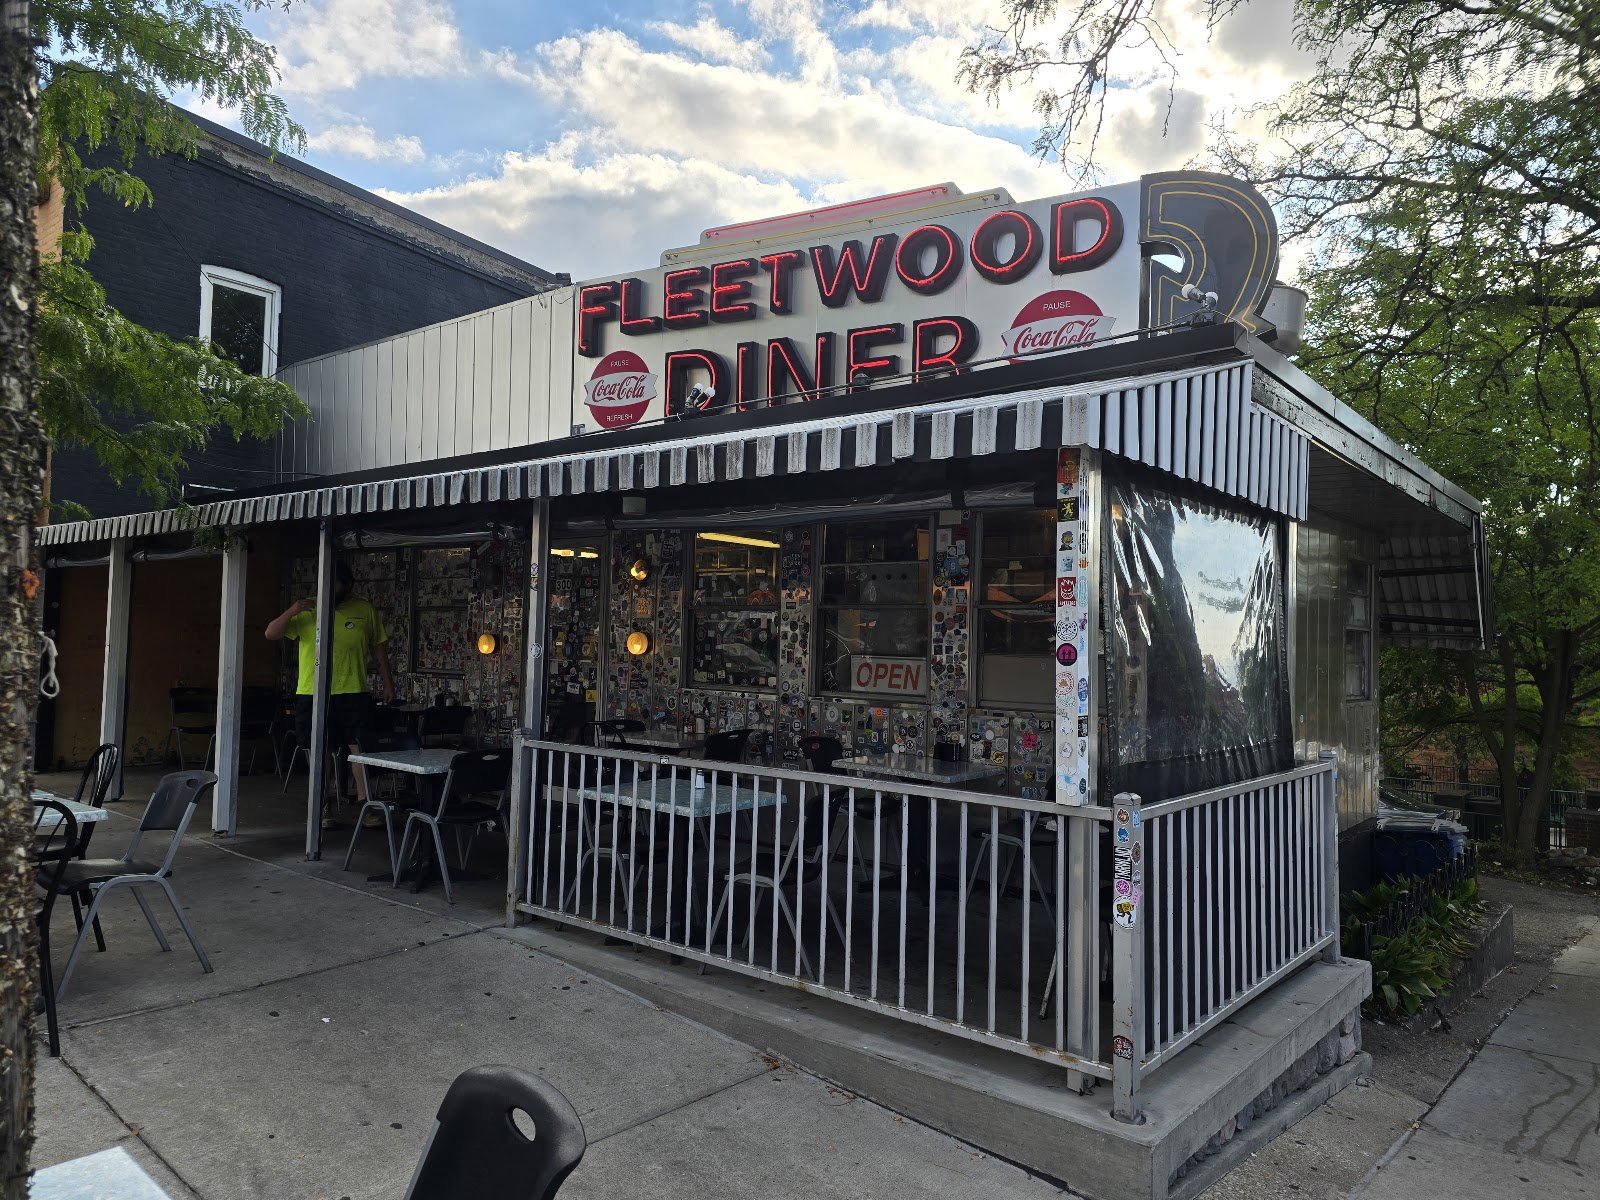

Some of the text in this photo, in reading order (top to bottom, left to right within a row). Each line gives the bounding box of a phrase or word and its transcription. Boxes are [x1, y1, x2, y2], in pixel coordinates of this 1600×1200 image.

[578, 197, 1124, 358] FLEETWOOD
[1042, 300, 1072, 311] PAUSE
[1013, 318, 1100, 355] Coca-Cola
[610, 359, 629, 367] PAUSE
[664, 315, 980, 417] DINER
[591, 374, 647, 402] Coca-Cola
[606, 413, 633, 422] REFRESH
[556, 580, 572, 591] 300
[856, 662, 921, 690] OPEN
